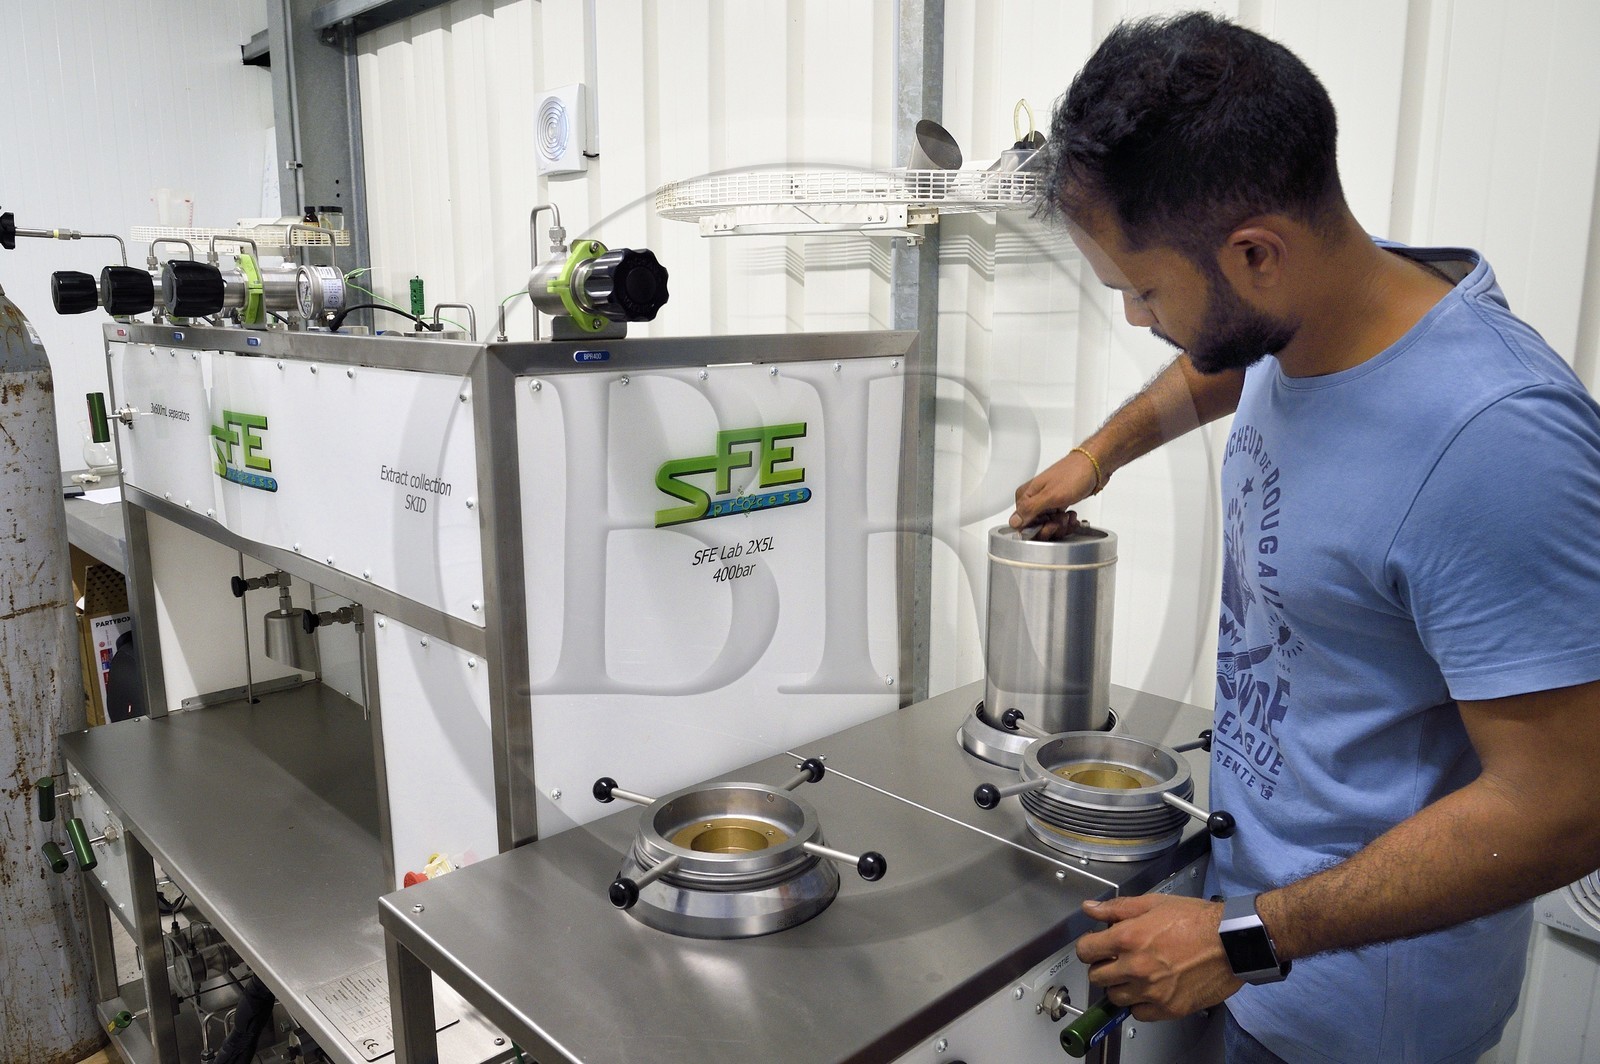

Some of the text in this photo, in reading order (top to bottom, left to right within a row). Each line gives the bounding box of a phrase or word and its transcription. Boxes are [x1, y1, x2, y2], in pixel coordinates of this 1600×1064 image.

[168, 408, 190, 421] separators
[1259, 451, 1272, 474] DE
[380, 464, 452, 496] Extract collection
[655, 422, 807, 528] SFE
[404, 494, 427, 513] SKID
[692, 536, 775, 566] SFE Lab 2X5L
[712, 564, 756, 583] 400bar
[1213, 709, 1284, 776] EAGUE
[1049, 955, 1070, 976] SORTIE
